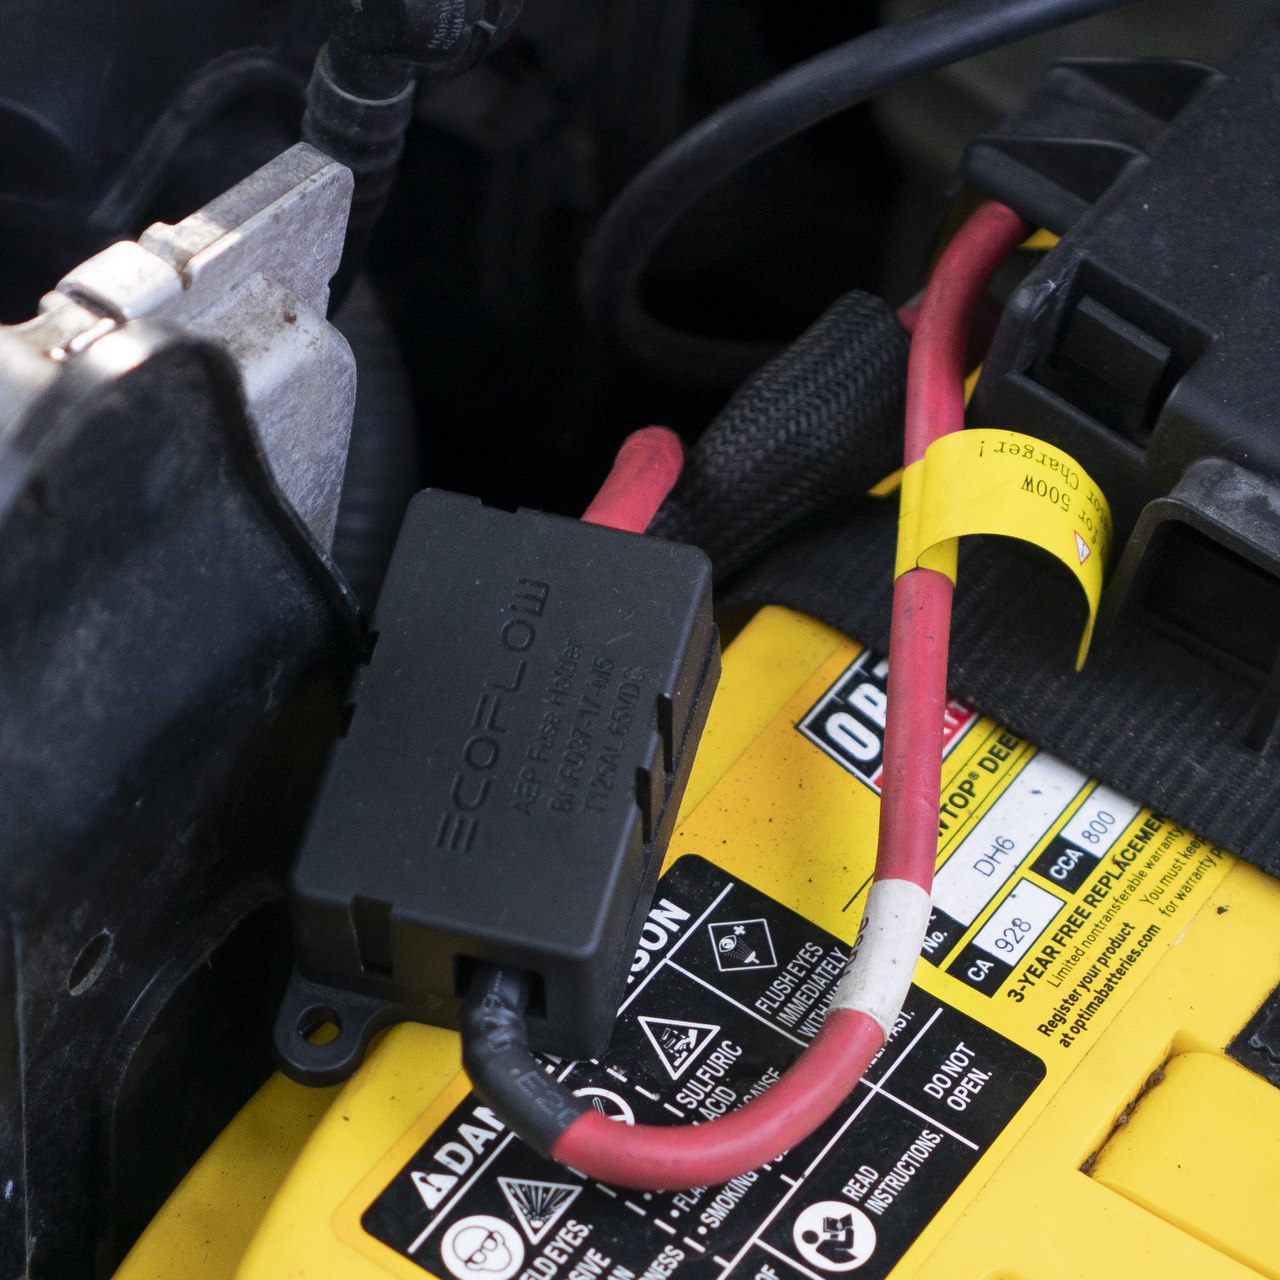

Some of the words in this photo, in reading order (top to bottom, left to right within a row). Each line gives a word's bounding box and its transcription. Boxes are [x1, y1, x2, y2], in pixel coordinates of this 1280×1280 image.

[1020, 473, 1071, 512] 500W
[542, 636, 584, 708] Holder
[436, 576, 550, 854] ECOFLOW
[524, 710, 562, 763] Fuse
[972, 835, 1015, 878] DH6
[1049, 848, 1084, 880] CCA
[1081, 810, 1116, 844] 800
[1139, 885, 1165, 906] You
[1159, 858, 1187, 888] must
[1178, 834, 1208, 861] keep
[1006, 944, 1062, 1004] 3-YEAR
[1051, 904, 1093, 948] FREE
[1082, 813, 1168, 910] REPLACEMEN
[1158, 900, 1179, 918] for
[1174, 855, 1218, 902] warranty
[923, 929, 948, 954] No.
[967, 958, 995, 982] CA
[994, 917, 1032, 953] 928
[1046, 948, 1086, 989] Limited
[1082, 868, 1148, 951] nontransferable
[754, 971, 796, 1015] FLUSH
[786, 941, 824, 978] EYES
[776, 946, 849, 1028] IMMEDIATELY
[1036, 983, 1085, 1038] Register
[1078, 961, 1107, 994] your
[1099, 921, 1136, 969] product
[1059, 1032, 1075, 1048] at
[1069, 923, 1162, 1036] optimabatteries.com
[797, 1003, 828, 1038] WITH
[675, 1040, 743, 1109] SULFURIC
[922, 1073, 952, 1100] DO
[940, 1041, 976, 1079] NOT
[946, 1067, 993, 1112] OPEN.
[698, 1085, 737, 1122] ACID
[700, 1170, 759, 1229] SMOKING
[841, 1165, 879, 1202] READ
[863, 1129, 945, 1216] INSTRUCTIONS.
[543, 1219, 593, 1264] EYES.
